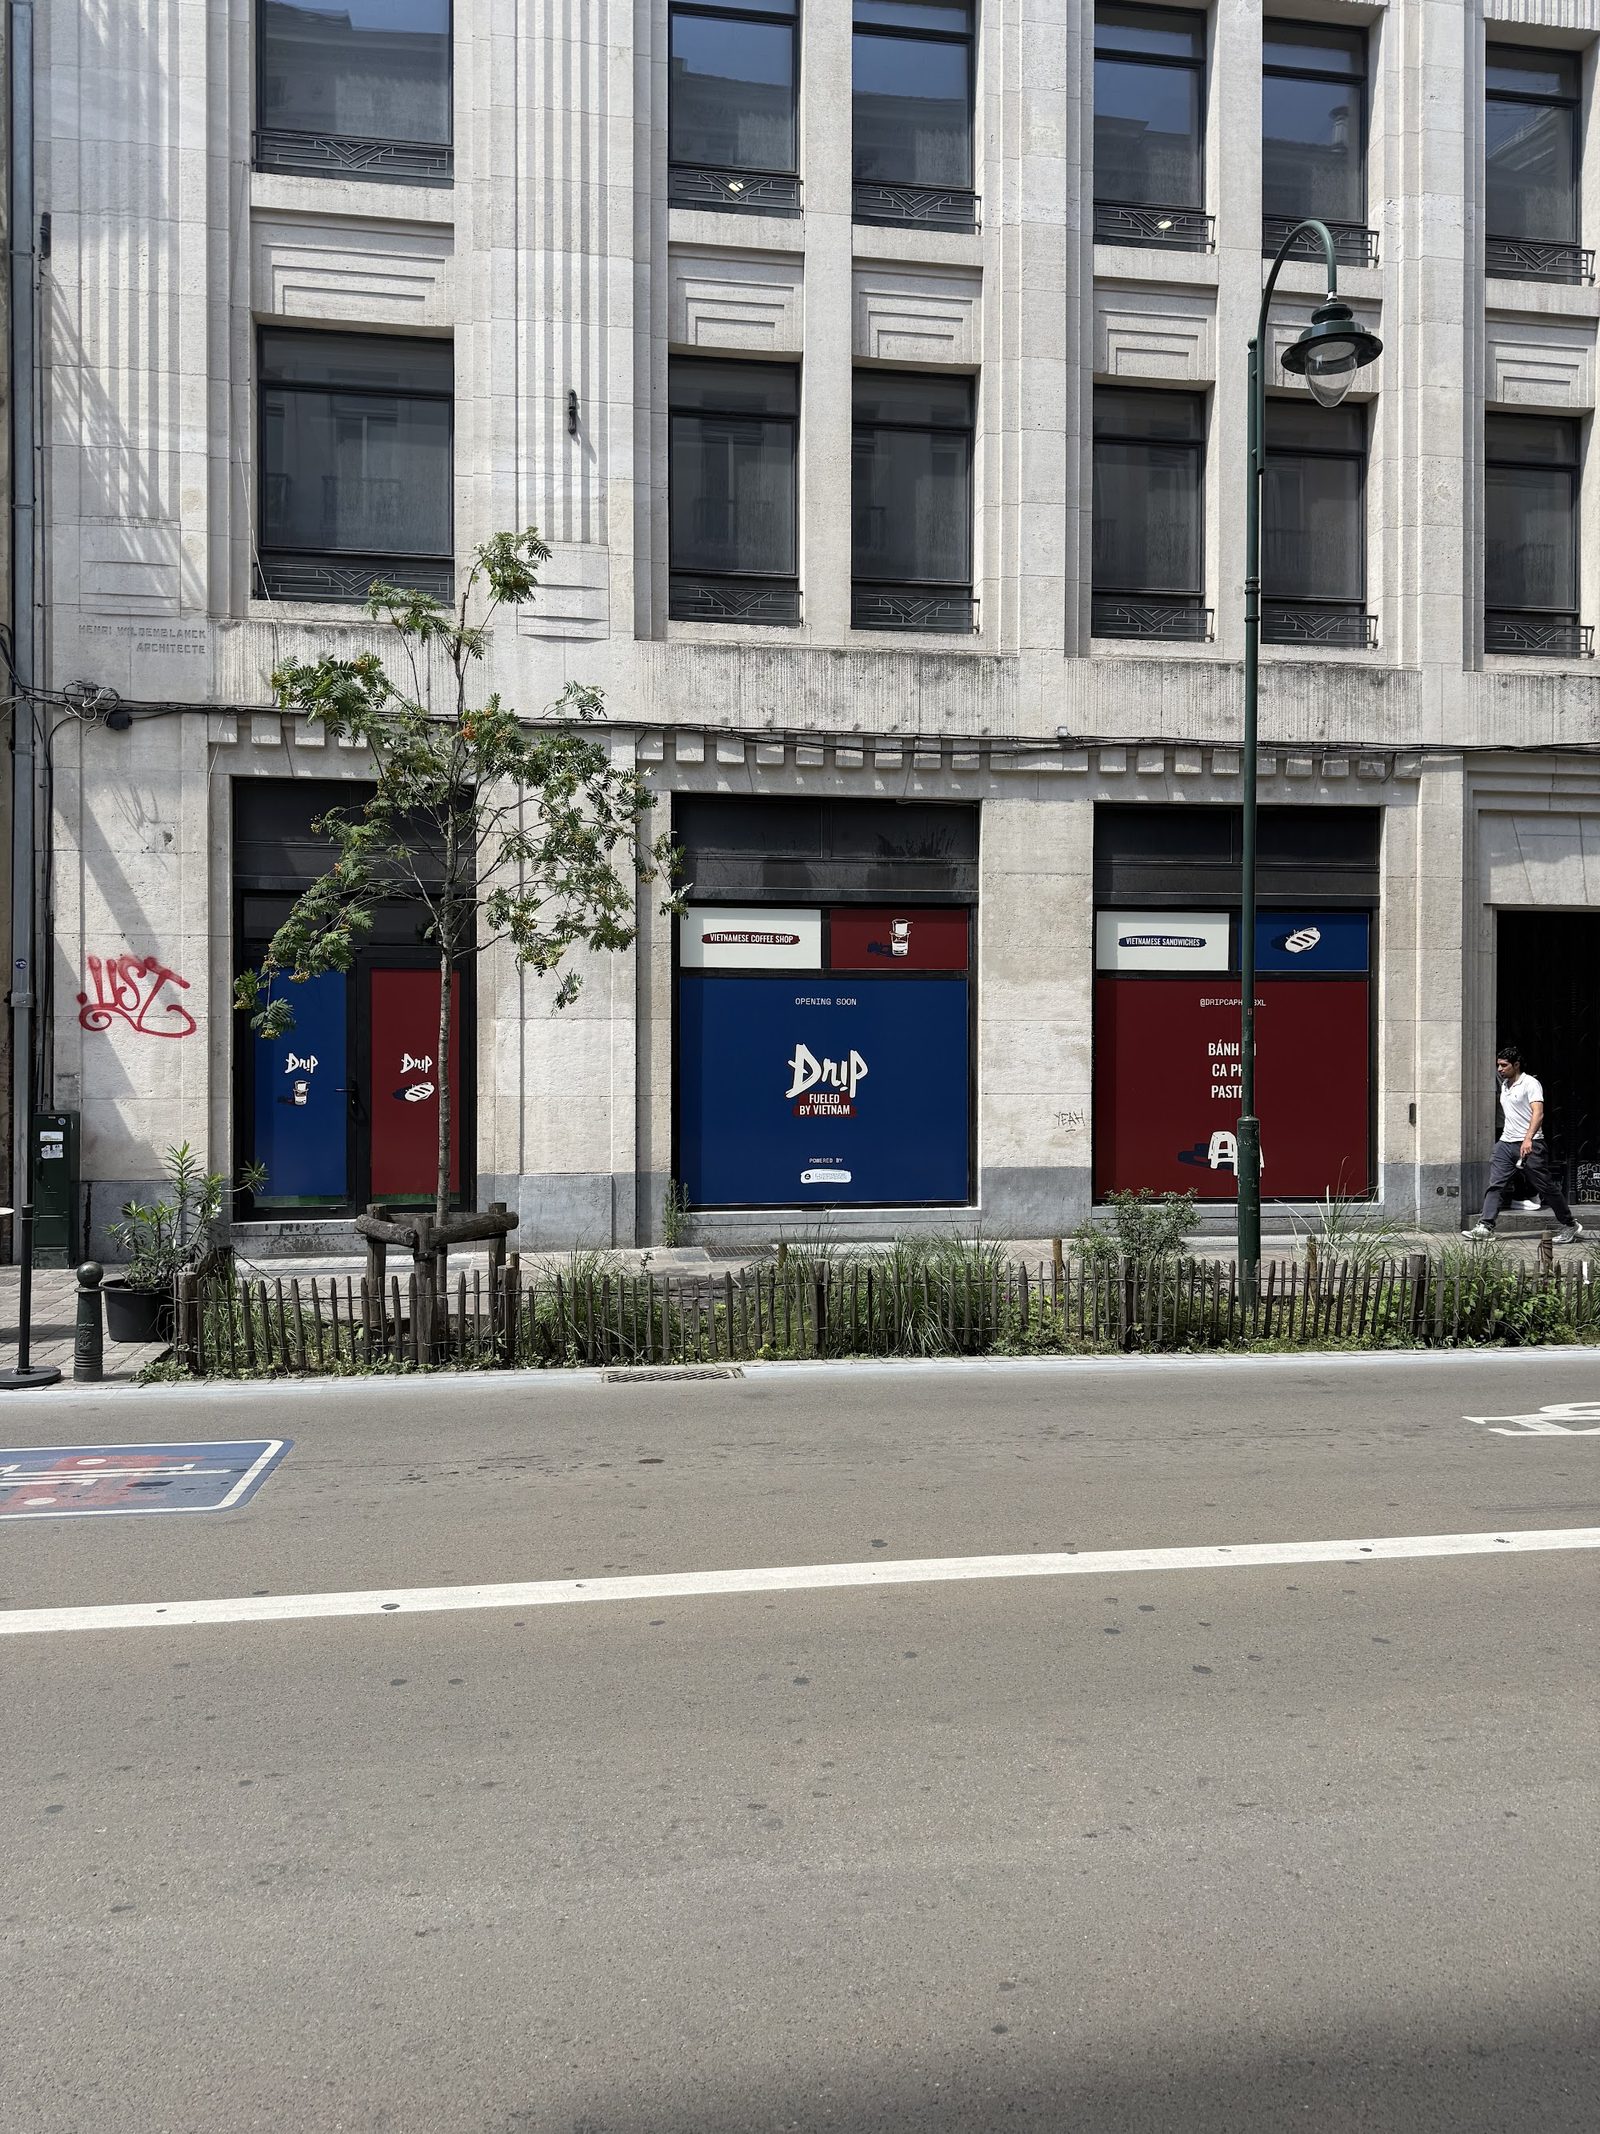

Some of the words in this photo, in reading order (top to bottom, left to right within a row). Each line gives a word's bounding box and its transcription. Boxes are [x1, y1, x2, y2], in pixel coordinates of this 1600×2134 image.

[136, 642, 206, 655] ARCHITECTE
[709, 933, 750, 943] VIETNAMESE
[750, 934, 774, 944] COFFEE
[775, 935, 794, 944] SHOP
[1125, 937, 1161, 946] VIETNAMESE
[1162, 937, 1201, 947] SANDWICHES
[795, 997, 832, 1006] OPENING
[835, 997, 857, 1006] SOON
[1208, 1039, 1239, 1056] BÁNH
[1212, 1063, 1227, 1077] CA
[809, 1093, 840, 1104] FUELED
[799, 1105, 811, 1115] BY
[812, 1104, 850, 1115] VIETNAM
[1053, 1109, 1086, 1127] YEAH
